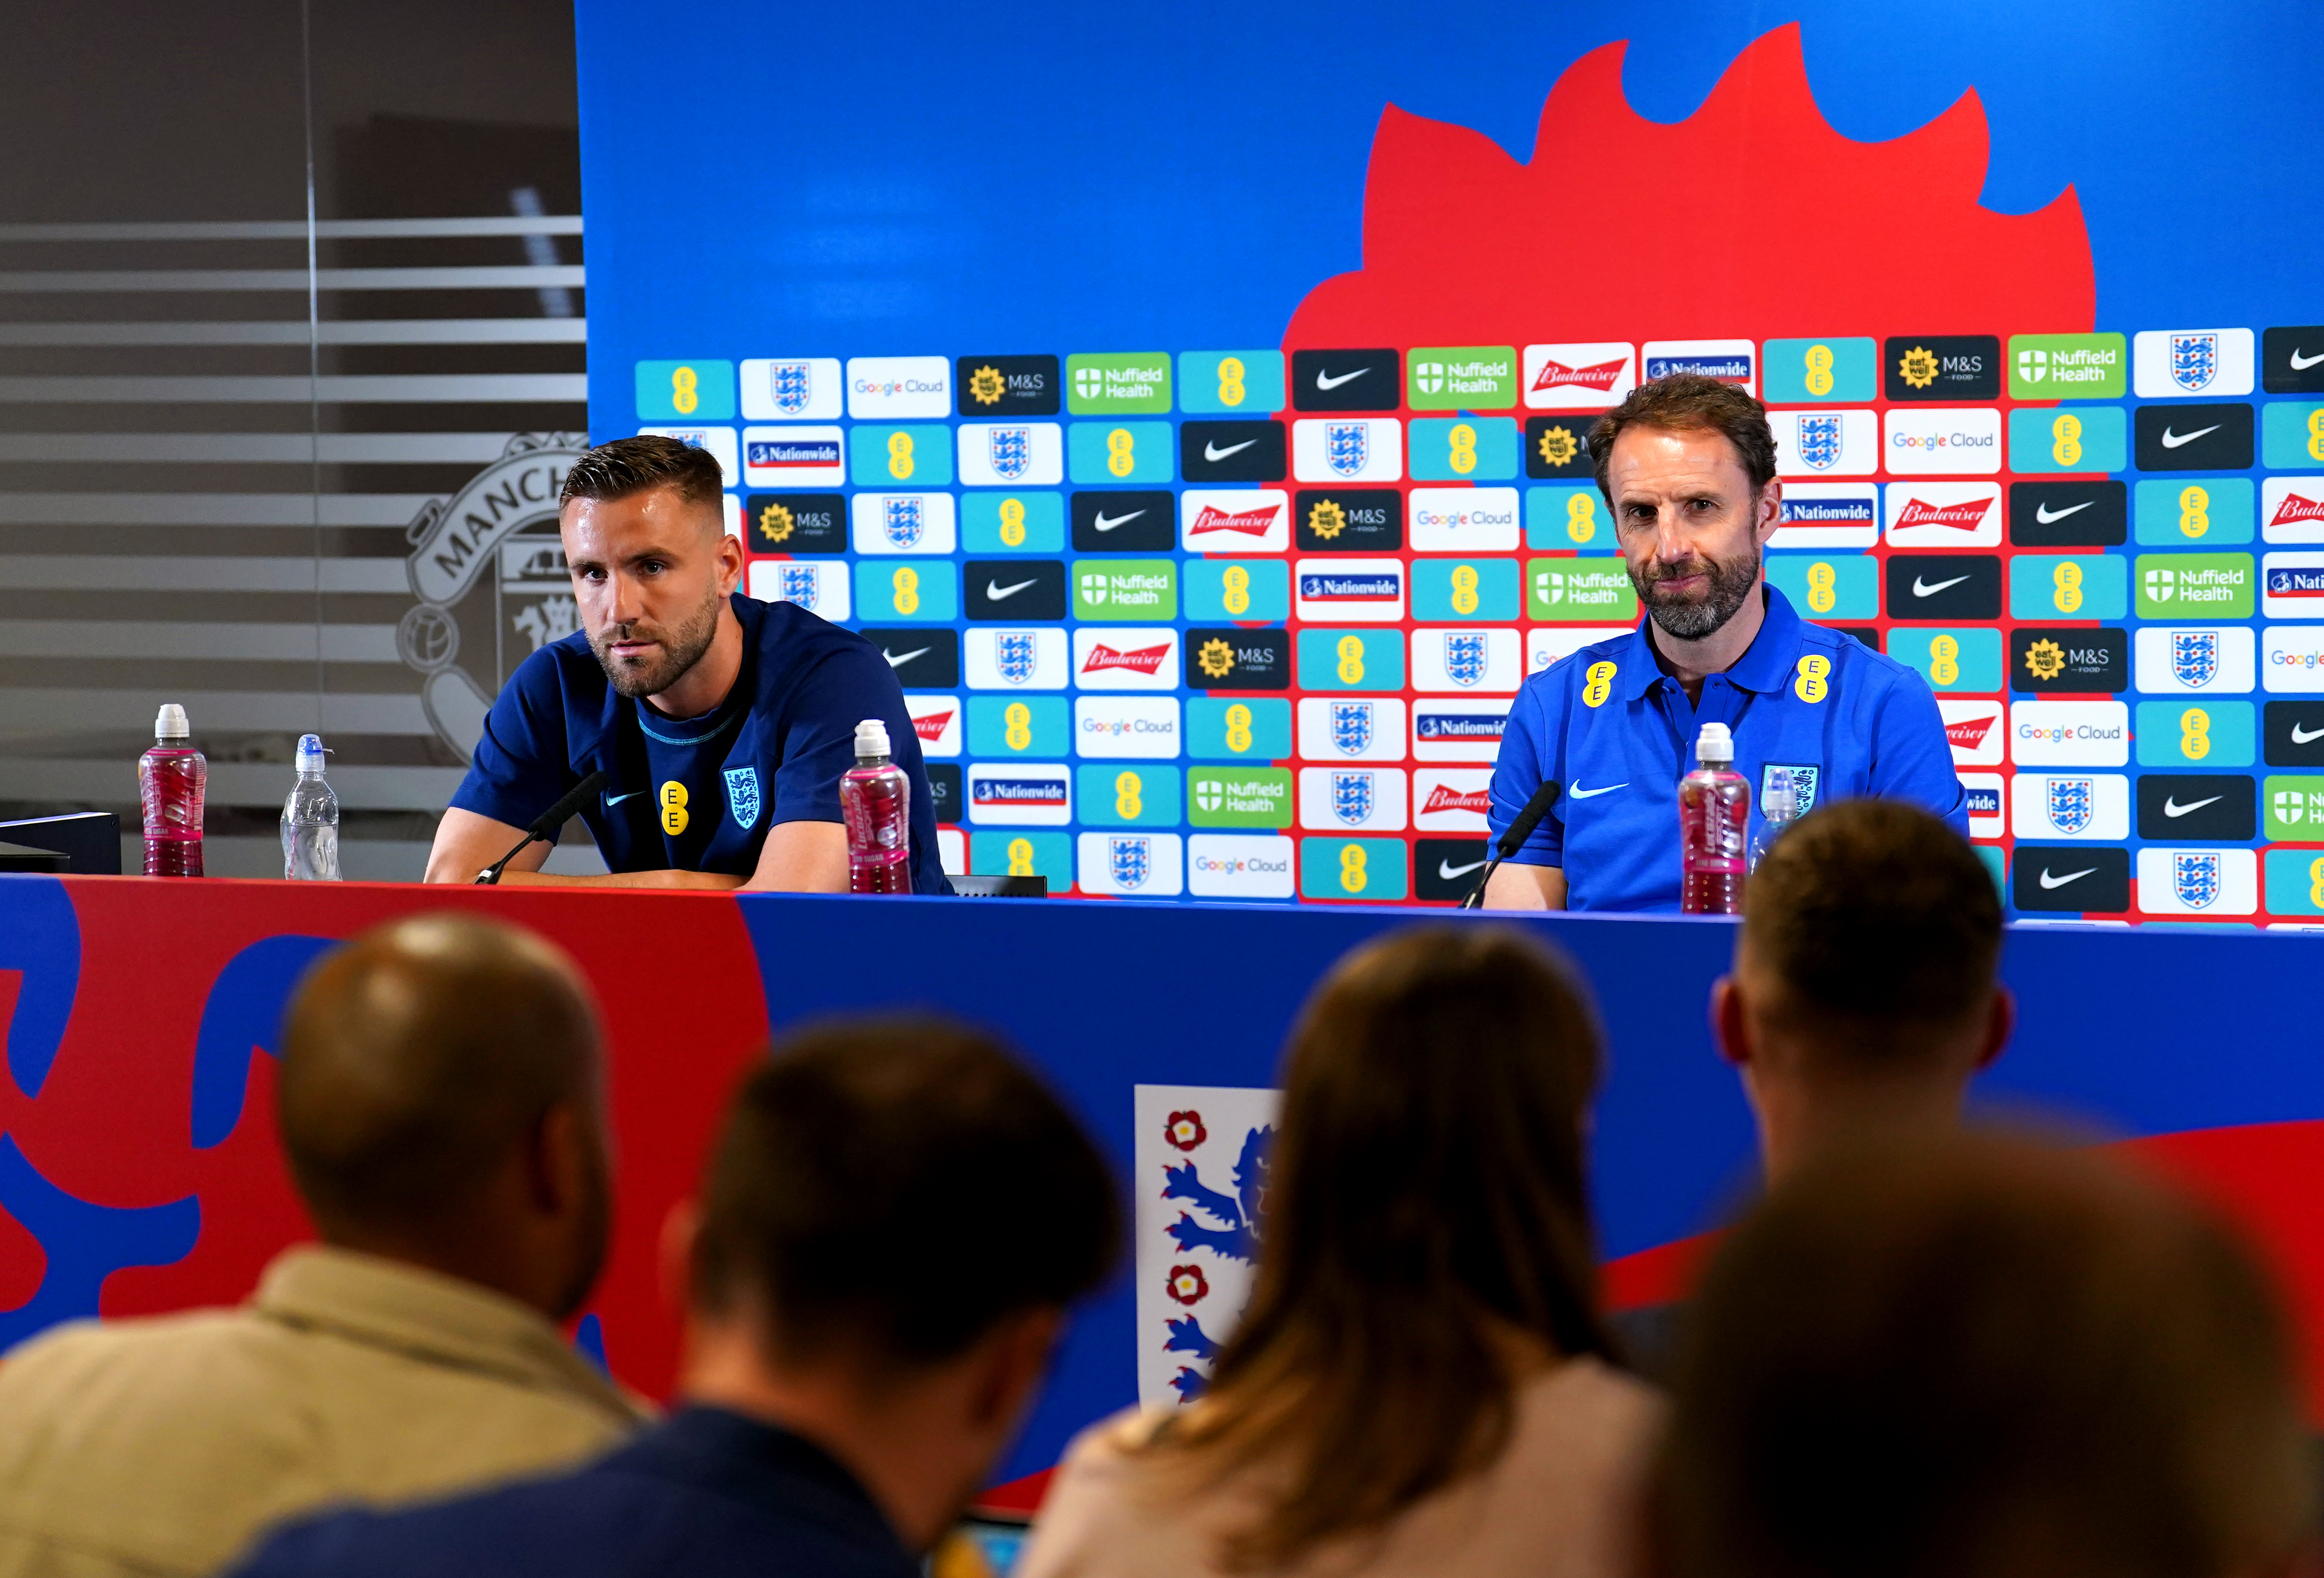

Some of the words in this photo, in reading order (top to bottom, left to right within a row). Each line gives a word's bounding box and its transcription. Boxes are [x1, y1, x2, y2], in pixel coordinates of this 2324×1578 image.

[1909, 358, 1925, 366] eat
[1943, 357, 1982, 372] M&S
[2053, 350, 2116, 364] Nuffield
[1106, 368, 1163, 383] Nuffield
[1448, 363, 1507, 377] Nuffield
[1539, 367, 1620, 383] Budweiser
[2053, 366, 2105, 382] Health
[855, 380, 901, 396] Google
[905, 380, 943, 392] Cloud
[1009, 374, 1044, 389] M&S
[1448, 377, 1498, 393] Health
[1106, 382, 1153, 398] Health
[1549, 436, 1564, 444] eat
[1893, 433, 1946, 450] Google
[1951, 433, 1993, 447] Cloud
[769, 446, 837, 462] Nationwide
[1349, 509, 1386, 524] M&S
[1794, 504, 1870, 519] Nationwide
[1902, 505, 1985, 522] Budweiser
[434, 466, 568, 579] MANCH
[797, 513, 831, 528] M&S
[1196, 511, 1273, 528] Budweiser
[1418, 511, 1467, 528] Google
[1472, 511, 1511, 524] Cloud
[1111, 575, 1168, 590] Nuffield
[1569, 573, 1628, 587] Nuffield
[2180, 570, 2244, 585] Nuffield
[1324, 580, 1396, 595] Nationwide
[2180, 586, 2233, 602] Health
[1112, 591, 1159, 604] Health
[1569, 589, 1618, 604] Health
[1088, 651, 1163, 667] Budweiser
[1238, 648, 1274, 663] M&S
[2035, 649, 2053, 658] eat
[2069, 649, 2109, 665] M&S
[2036, 657, 2056, 667] well
[1084, 718, 1130, 735] Google
[1135, 719, 1172, 733] Cloud
[2020, 724, 2073, 742] Google
[2078, 725, 2120, 739] Cloud
[995, 785, 1064, 799] Nationwide
[1227, 782, 1284, 796] Nuffield
[1227, 797, 1274, 812] Health
[1196, 856, 1244, 874] Google
[1249, 858, 1287, 872] Cloud
